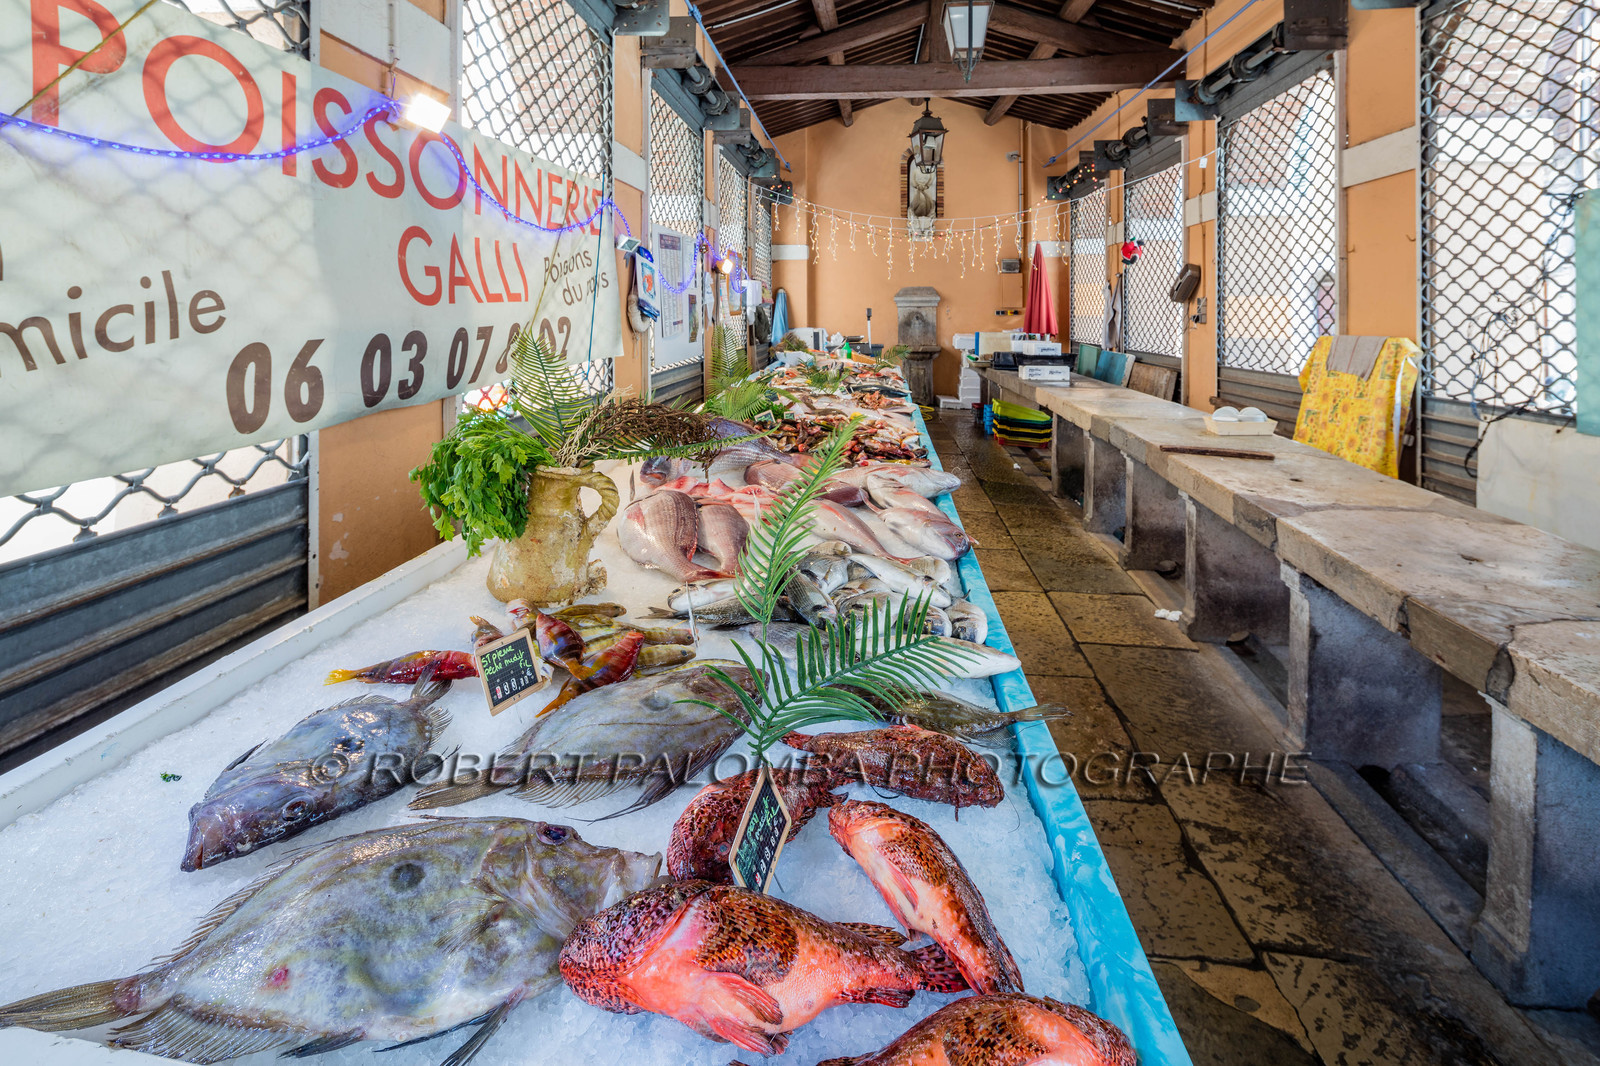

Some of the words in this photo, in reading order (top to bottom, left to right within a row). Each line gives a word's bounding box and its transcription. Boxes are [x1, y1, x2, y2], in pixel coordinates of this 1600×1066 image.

[31, 0, 603, 236] POISSONNERIE
[398, 226, 528, 306] GALLI
[563, 277, 582, 306] du
[226, 339, 325, 434] 06
[360, 330, 428, 408] 03
[447, 326, 494, 390] 07
